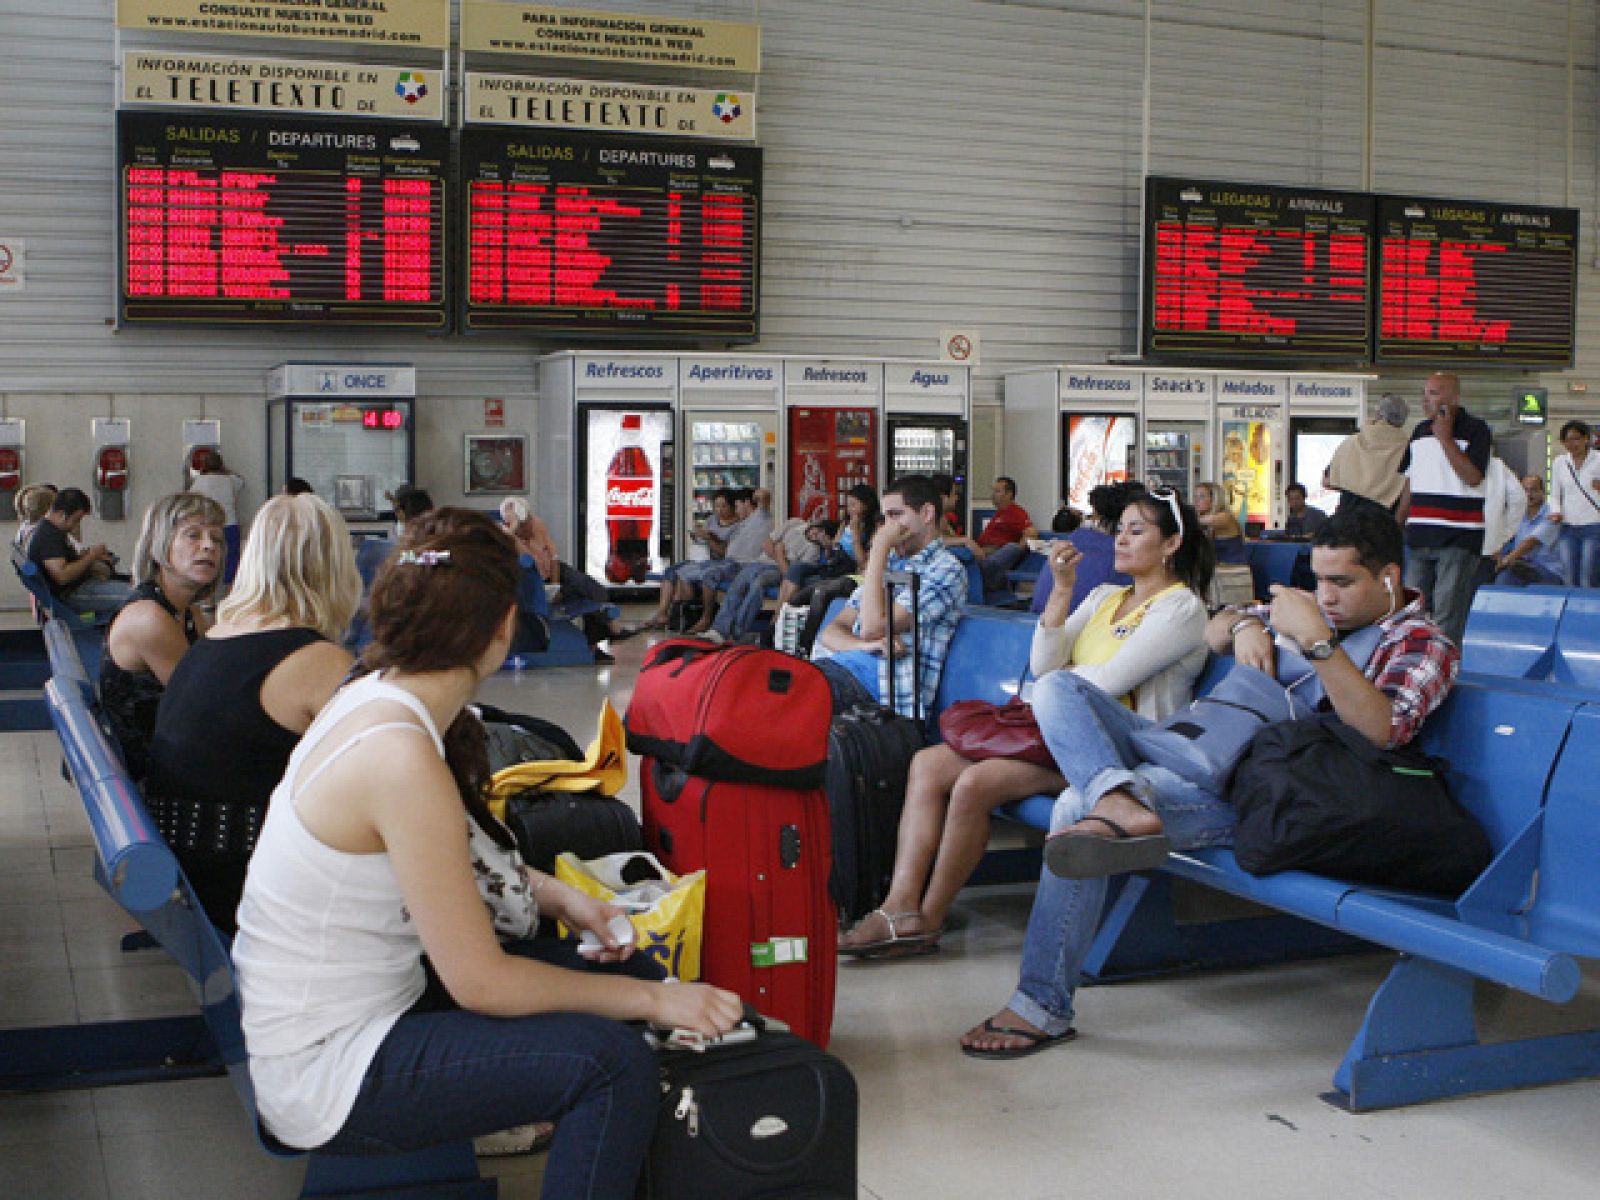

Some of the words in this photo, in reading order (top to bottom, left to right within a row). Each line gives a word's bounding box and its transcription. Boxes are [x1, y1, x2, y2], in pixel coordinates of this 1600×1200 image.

[200, 4, 271, 19] CONSULTE
[275, 9, 340, 23] NUESTRA
[345, 14, 373, 25] WEB
[522, 12, 557, 25] PARA
[650, 24, 705, 38] GENERAL
[535, 27, 601, 44] CONSULTE
[604, 32, 661, 47] NUESTRA
[667, 39, 693, 51] WEB
[259, 65, 349, 83] DISPONIBLE
[357, 72, 379, 84] EN
[137, 86, 153, 99] EL
[168, 74, 345, 110] TELETEXTO
[357, 99, 376, 112] DE
[589, 87, 671, 104] DISPONIBLE
[677, 93, 696, 104] EN
[479, 104, 496, 119] EL
[508, 95, 668, 129] TELETEXTO
[677, 119, 696, 131] DE
[165, 125, 241, 143] SALIDAS
[269, 130, 376, 150] DEPARTURES
[507, 144, 574, 161] SALIDAS
[600, 149, 696, 168] DEPARTURES
[1210, 192, 1271, 208] LLEGADAS
[1287, 199, 1344, 214] ARRIVALS
[1502, 213, 1551, 228] ARRIVALS
[585, 362, 664, 379] Refrescos
[689, 364, 774, 383] Aperitivos
[803, 367, 867, 384] Refrescos
[910, 370, 950, 388] Agua
[344, 374, 386, 389] ONCE
[1067, 376, 1131, 392] Refrescos
[1152, 376, 1206, 393] Snack's
[1295, 382, 1353, 398] Refrescos
